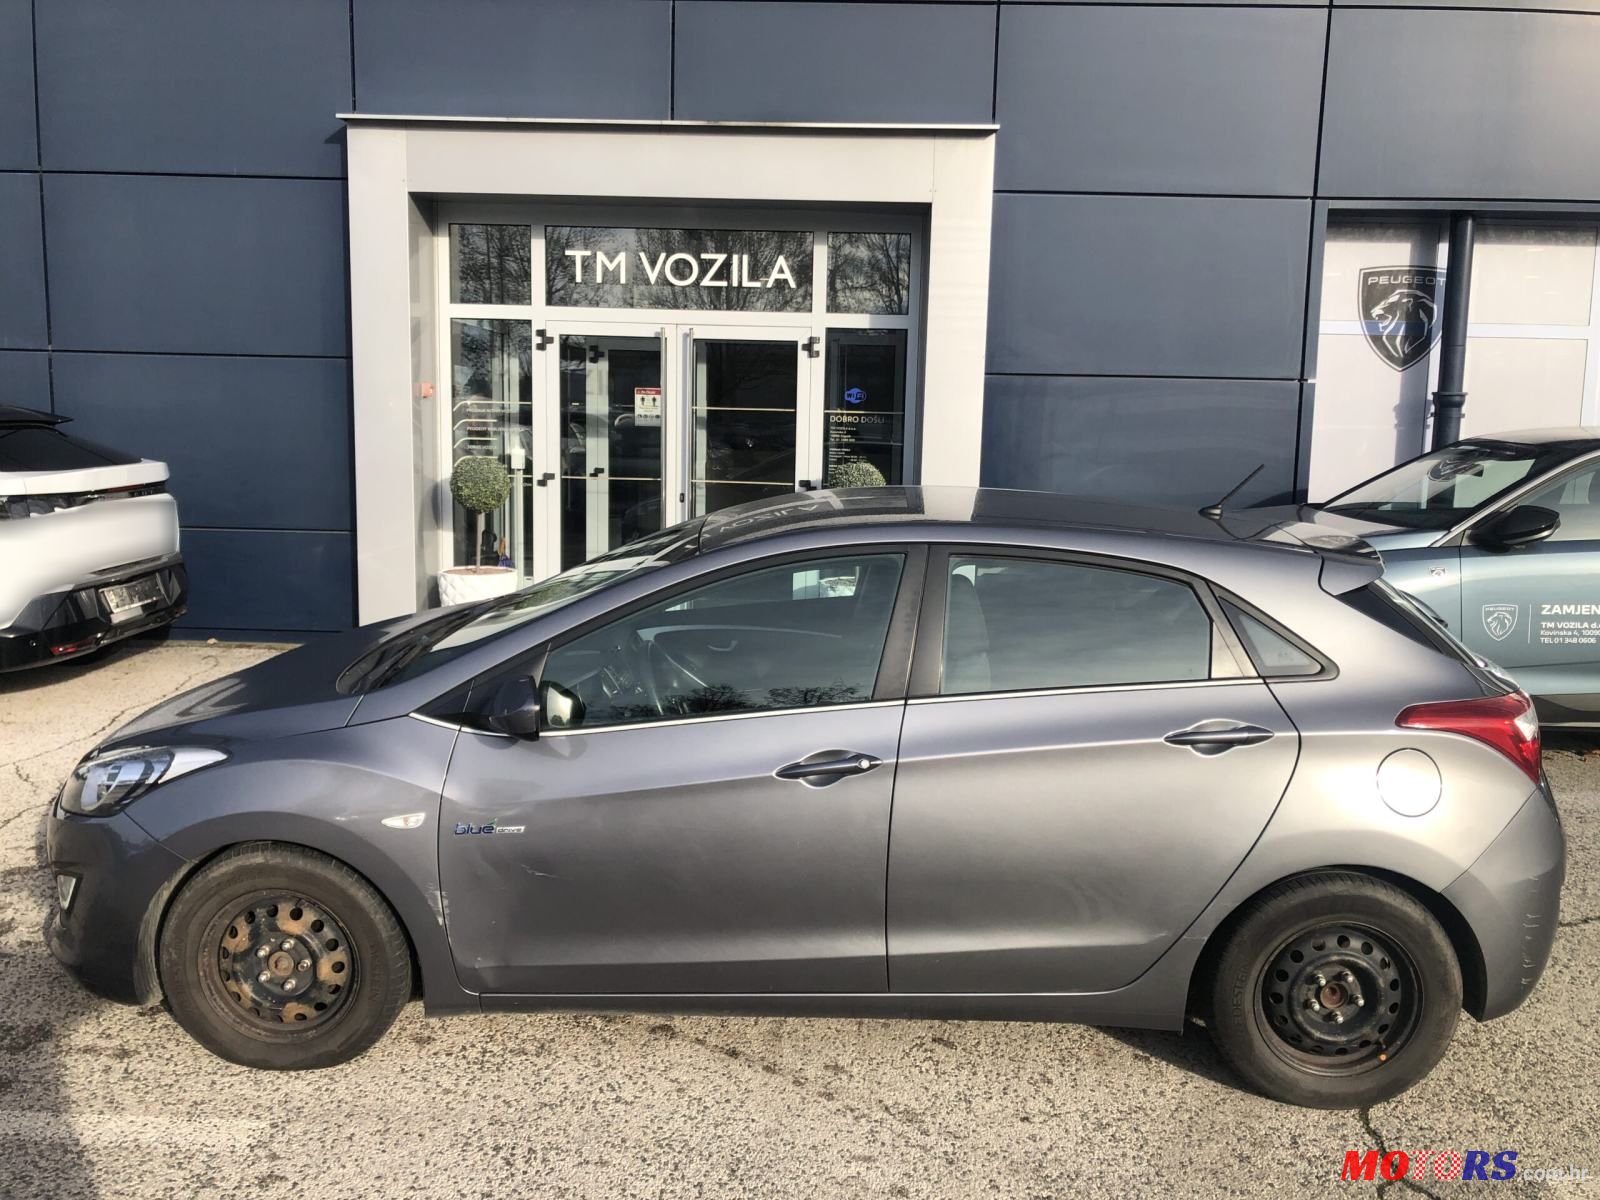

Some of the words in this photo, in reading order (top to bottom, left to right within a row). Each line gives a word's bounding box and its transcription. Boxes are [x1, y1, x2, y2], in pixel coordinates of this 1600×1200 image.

[565, 250, 626, 284] TM
[639, 252, 796, 288] VOZILA
[1367, 275, 1446, 286] PEUGEOT
[830, 415, 859, 423] DOBRO
[1541, 604, 1600, 615] ZAMJEN
[454, 822, 494, 835] blue
